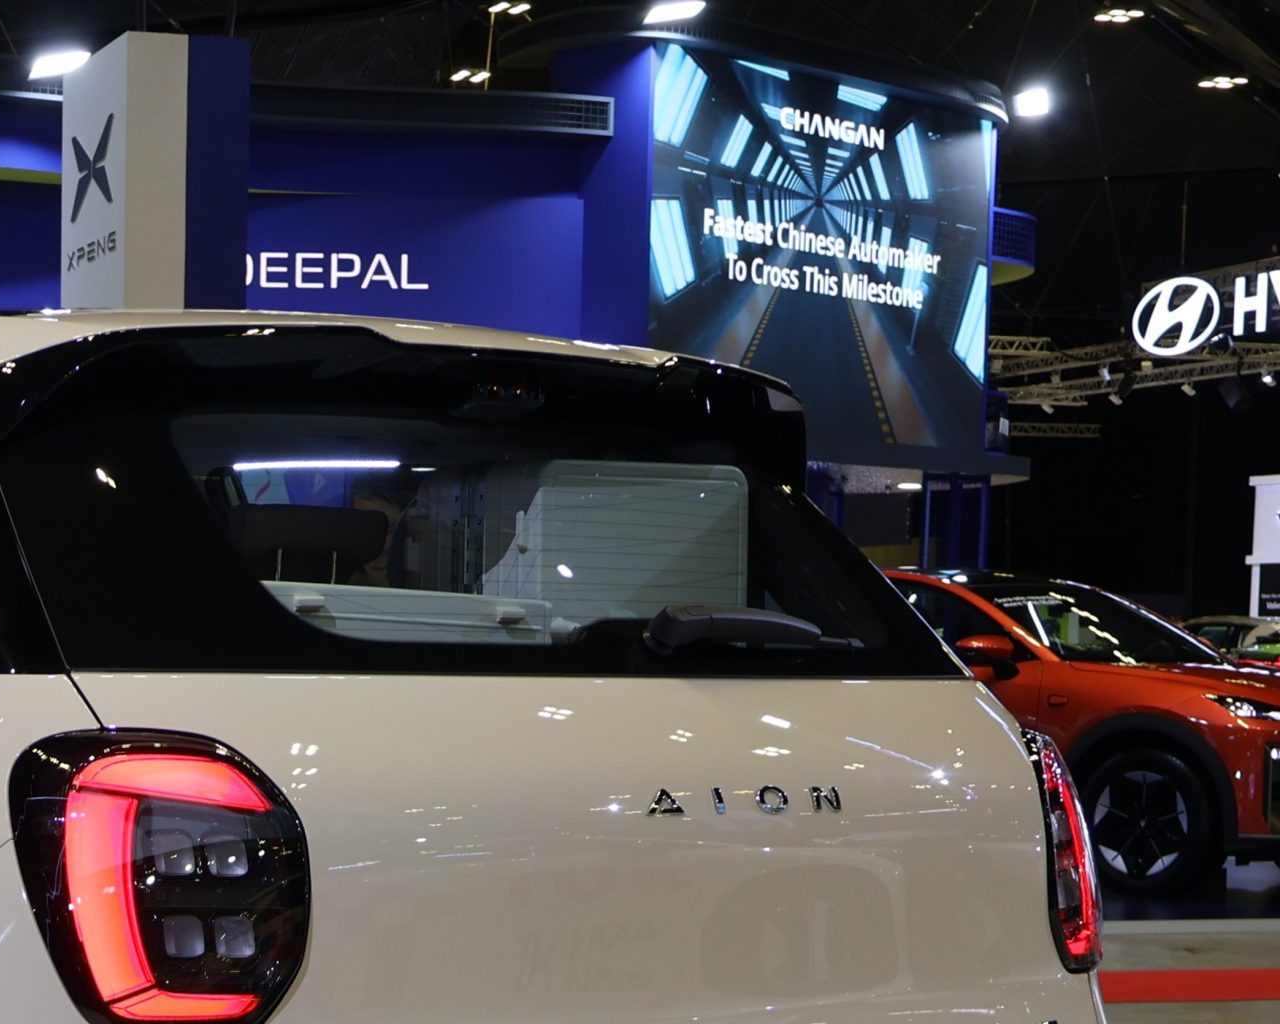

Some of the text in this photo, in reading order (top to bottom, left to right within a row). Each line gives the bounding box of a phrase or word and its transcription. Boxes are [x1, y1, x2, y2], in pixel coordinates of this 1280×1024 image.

[779, 106, 885, 150] CHANGAN
[67, 230, 117, 272] XPENG
[703, 207, 942, 275] Fastest Chinese Automaker
[726, 253, 924, 310] To Cross This Milestone
[1233, 270, 1280, 337] H
[646, 784, 842, 817] AION
